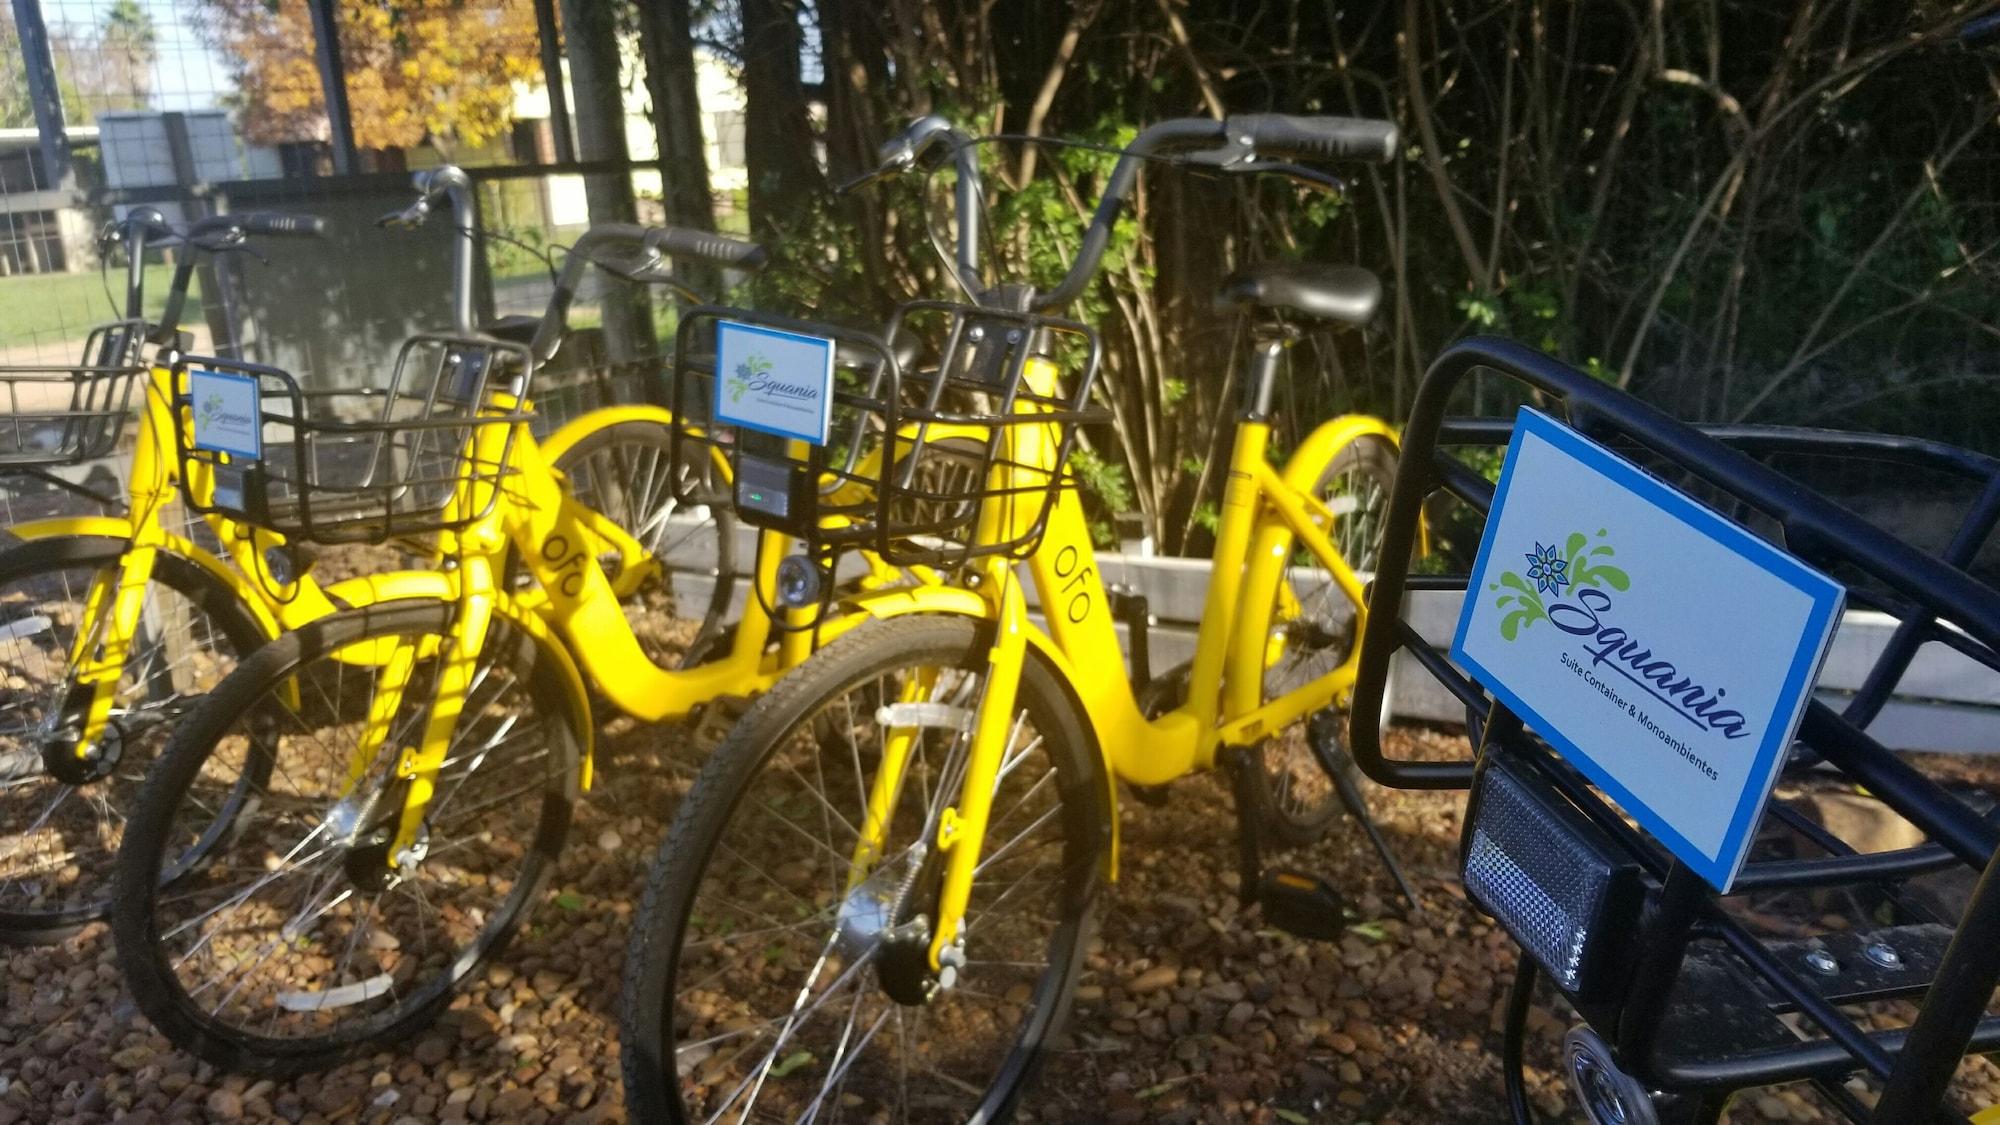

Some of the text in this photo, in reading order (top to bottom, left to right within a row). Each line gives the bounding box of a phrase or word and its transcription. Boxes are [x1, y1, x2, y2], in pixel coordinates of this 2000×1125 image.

[747, 371, 818, 401] Squania
[1548, 588, 1751, 740] Squania
[1560, 652, 1719, 781] Suite Container & Monoambientes
